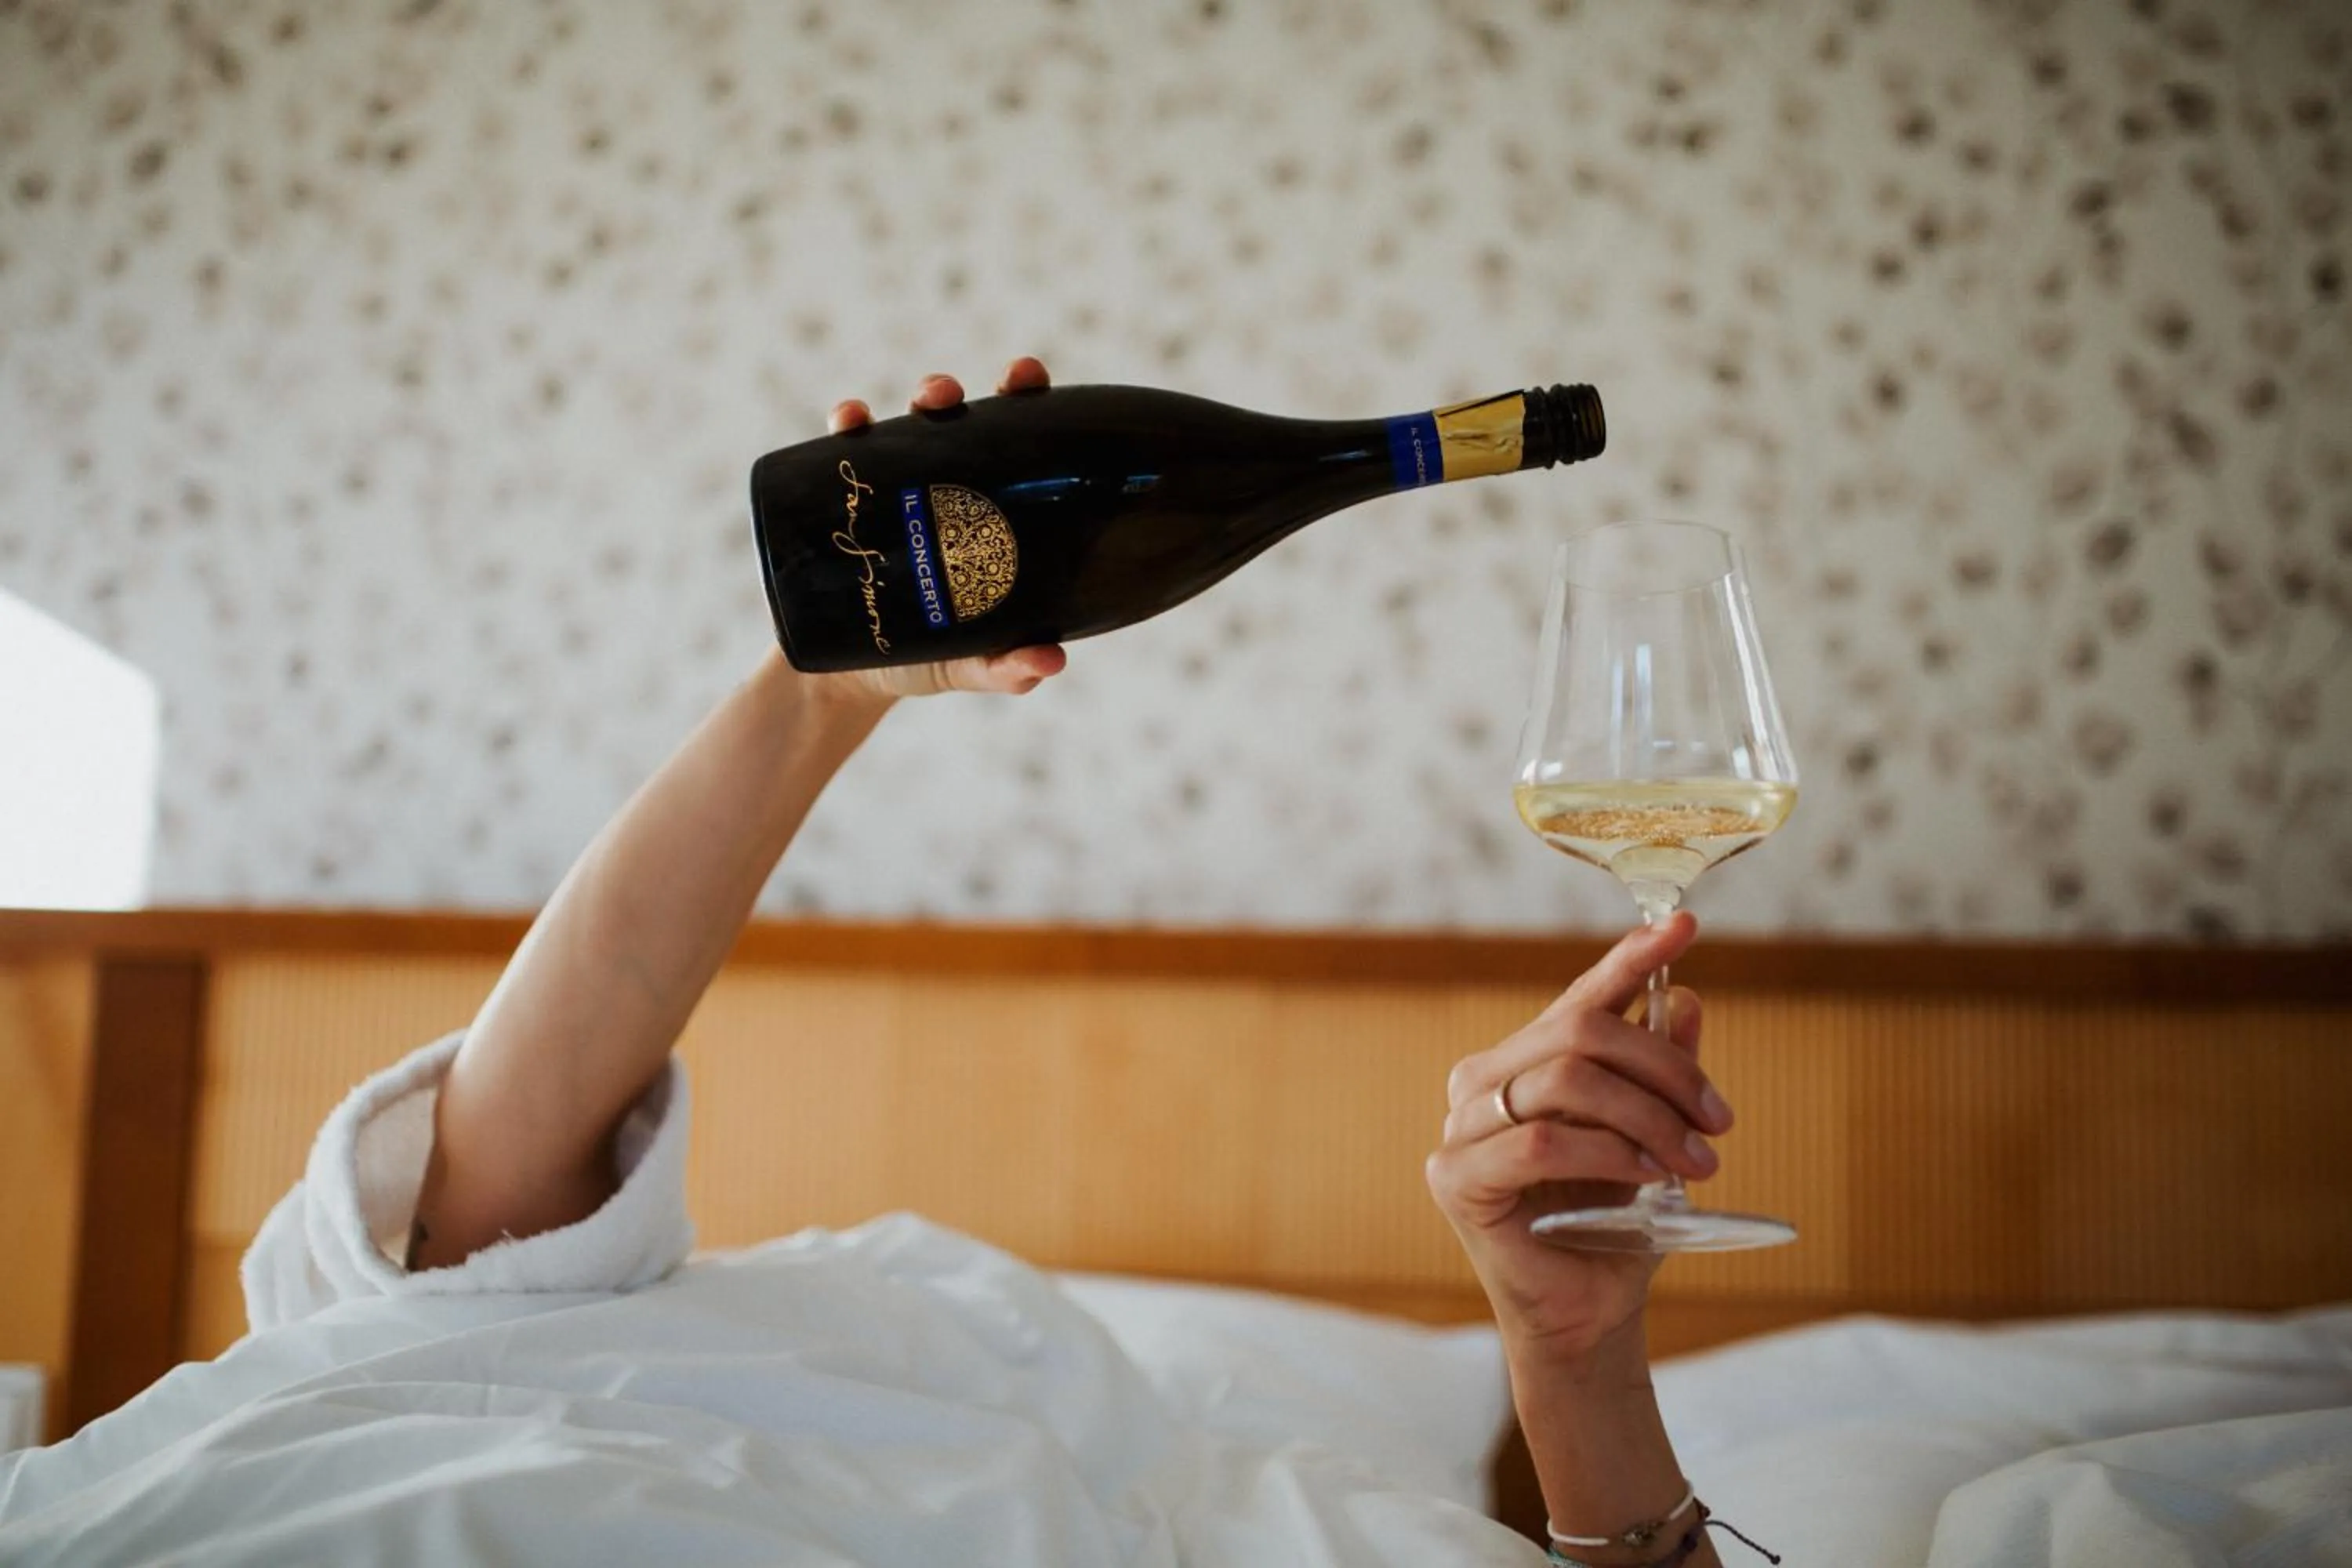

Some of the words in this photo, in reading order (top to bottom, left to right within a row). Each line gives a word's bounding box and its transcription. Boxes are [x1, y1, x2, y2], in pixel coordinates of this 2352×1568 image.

[839, 460, 873, 539] San
[904, 494, 919, 514] IL
[832, 532, 891, 655] Simone
[909, 519, 943, 623] CONCERTO
